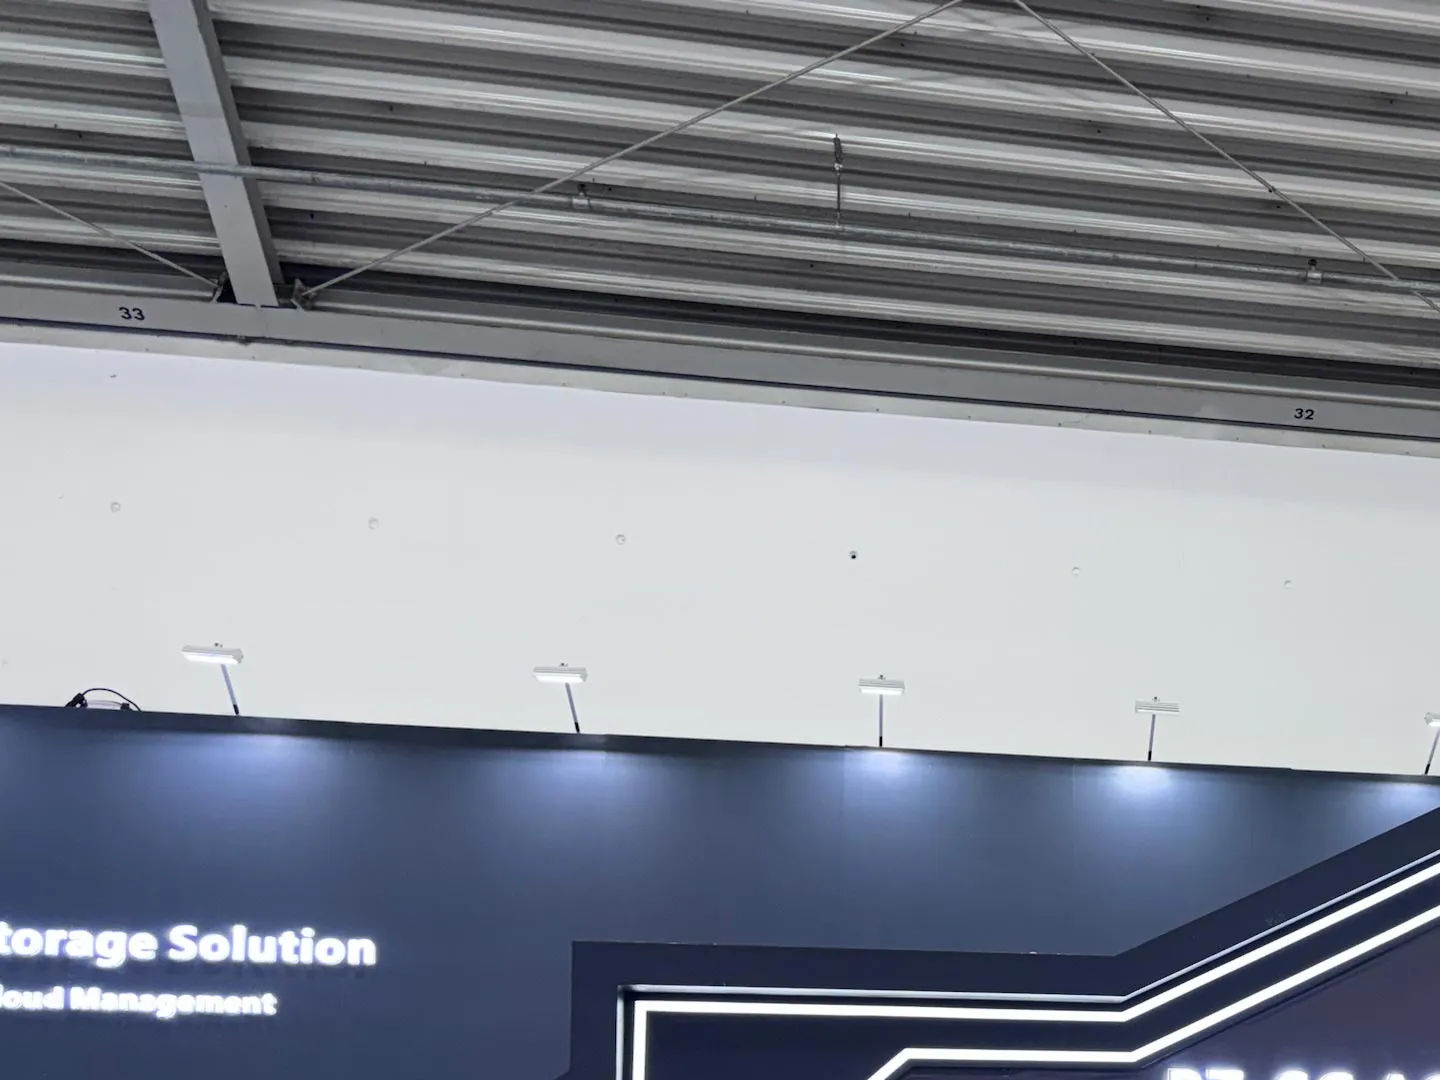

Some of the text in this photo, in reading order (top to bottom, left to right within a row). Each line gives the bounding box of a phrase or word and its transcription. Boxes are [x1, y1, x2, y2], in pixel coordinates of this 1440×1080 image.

[118, 306, 146, 321] 33
[1294, 407, 1315, 420] 32
[168, 924, 377, 967] Solution
[69, 985, 278, 1019] Management
